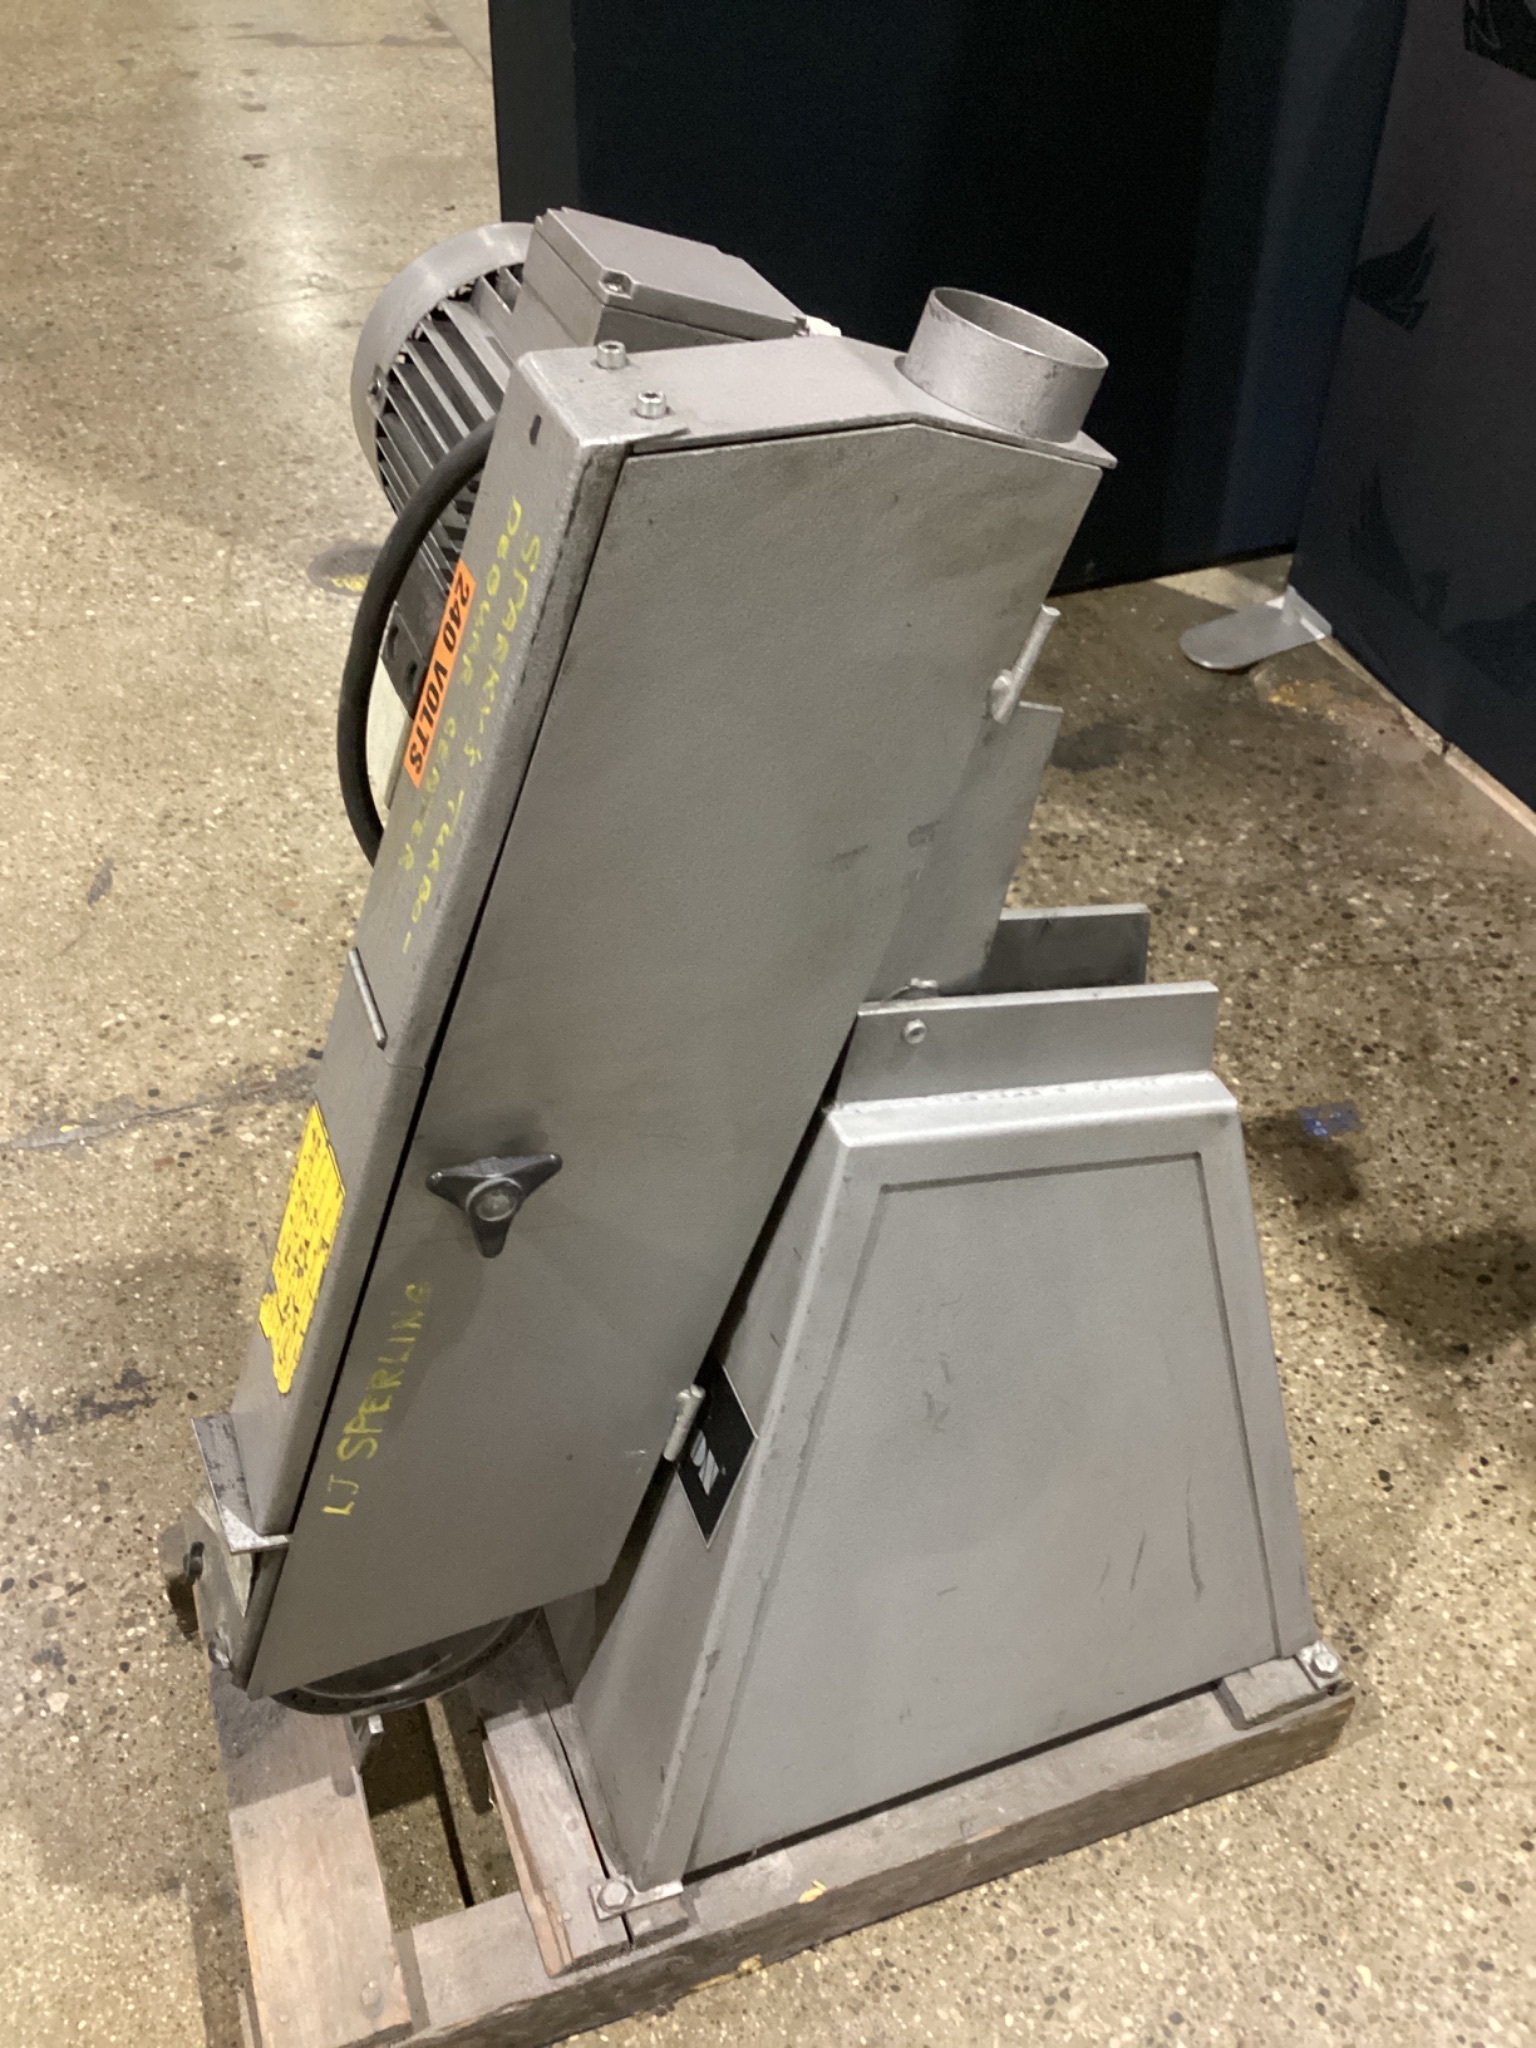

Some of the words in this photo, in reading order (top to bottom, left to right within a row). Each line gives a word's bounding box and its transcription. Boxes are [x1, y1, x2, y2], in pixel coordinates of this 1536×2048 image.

[443, 571, 470, 654] 240
[409, 659, 448, 775] VOLTS
[336, 1282, 431, 1462] SPERLING
[322, 1473, 360, 1516] LJ
